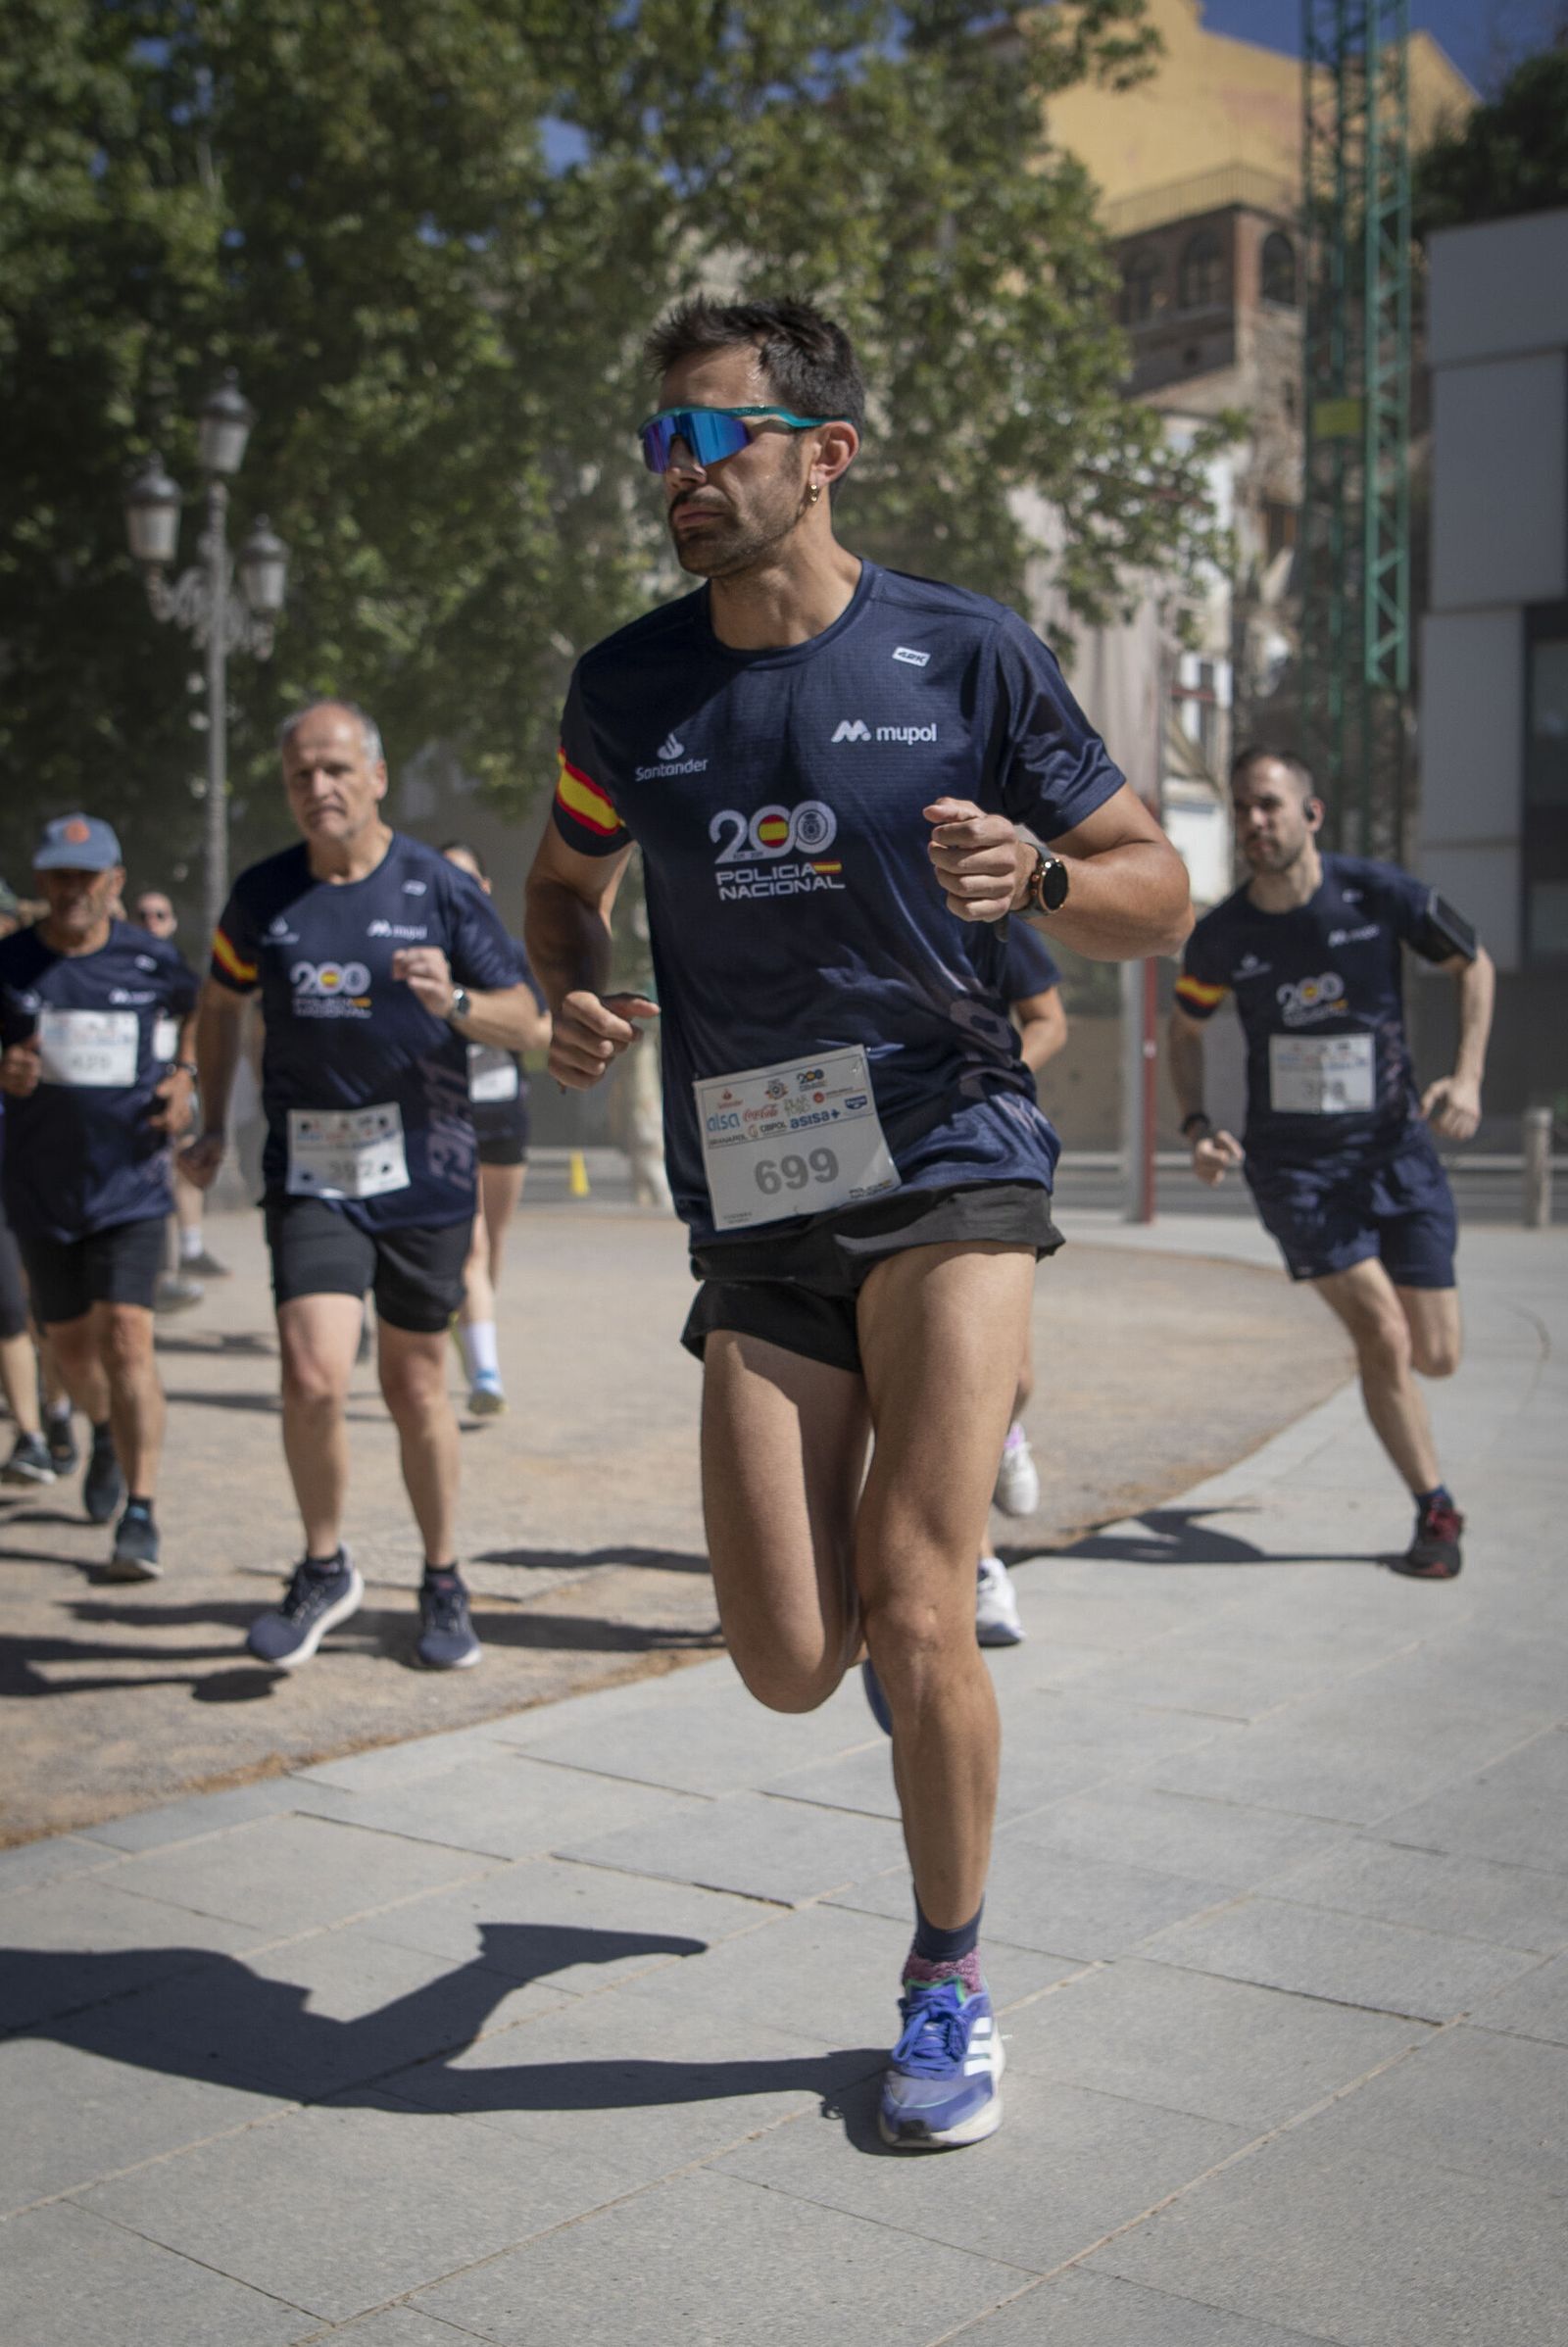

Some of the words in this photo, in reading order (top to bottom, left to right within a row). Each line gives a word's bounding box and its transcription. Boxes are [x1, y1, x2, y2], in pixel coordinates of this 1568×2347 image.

[876, 723, 937, 745] mupol
[635, 757, 708, 782] Santander
[709, 801, 838, 864] 200
[715, 862, 817, 886] POLICIA
[718, 875, 846, 901] NACIONAL
[290, 961, 372, 998] 200
[1276, 971, 1345, 1011] 200
[707, 1111, 740, 1131] alsa
[754, 1148, 839, 1195] 699
